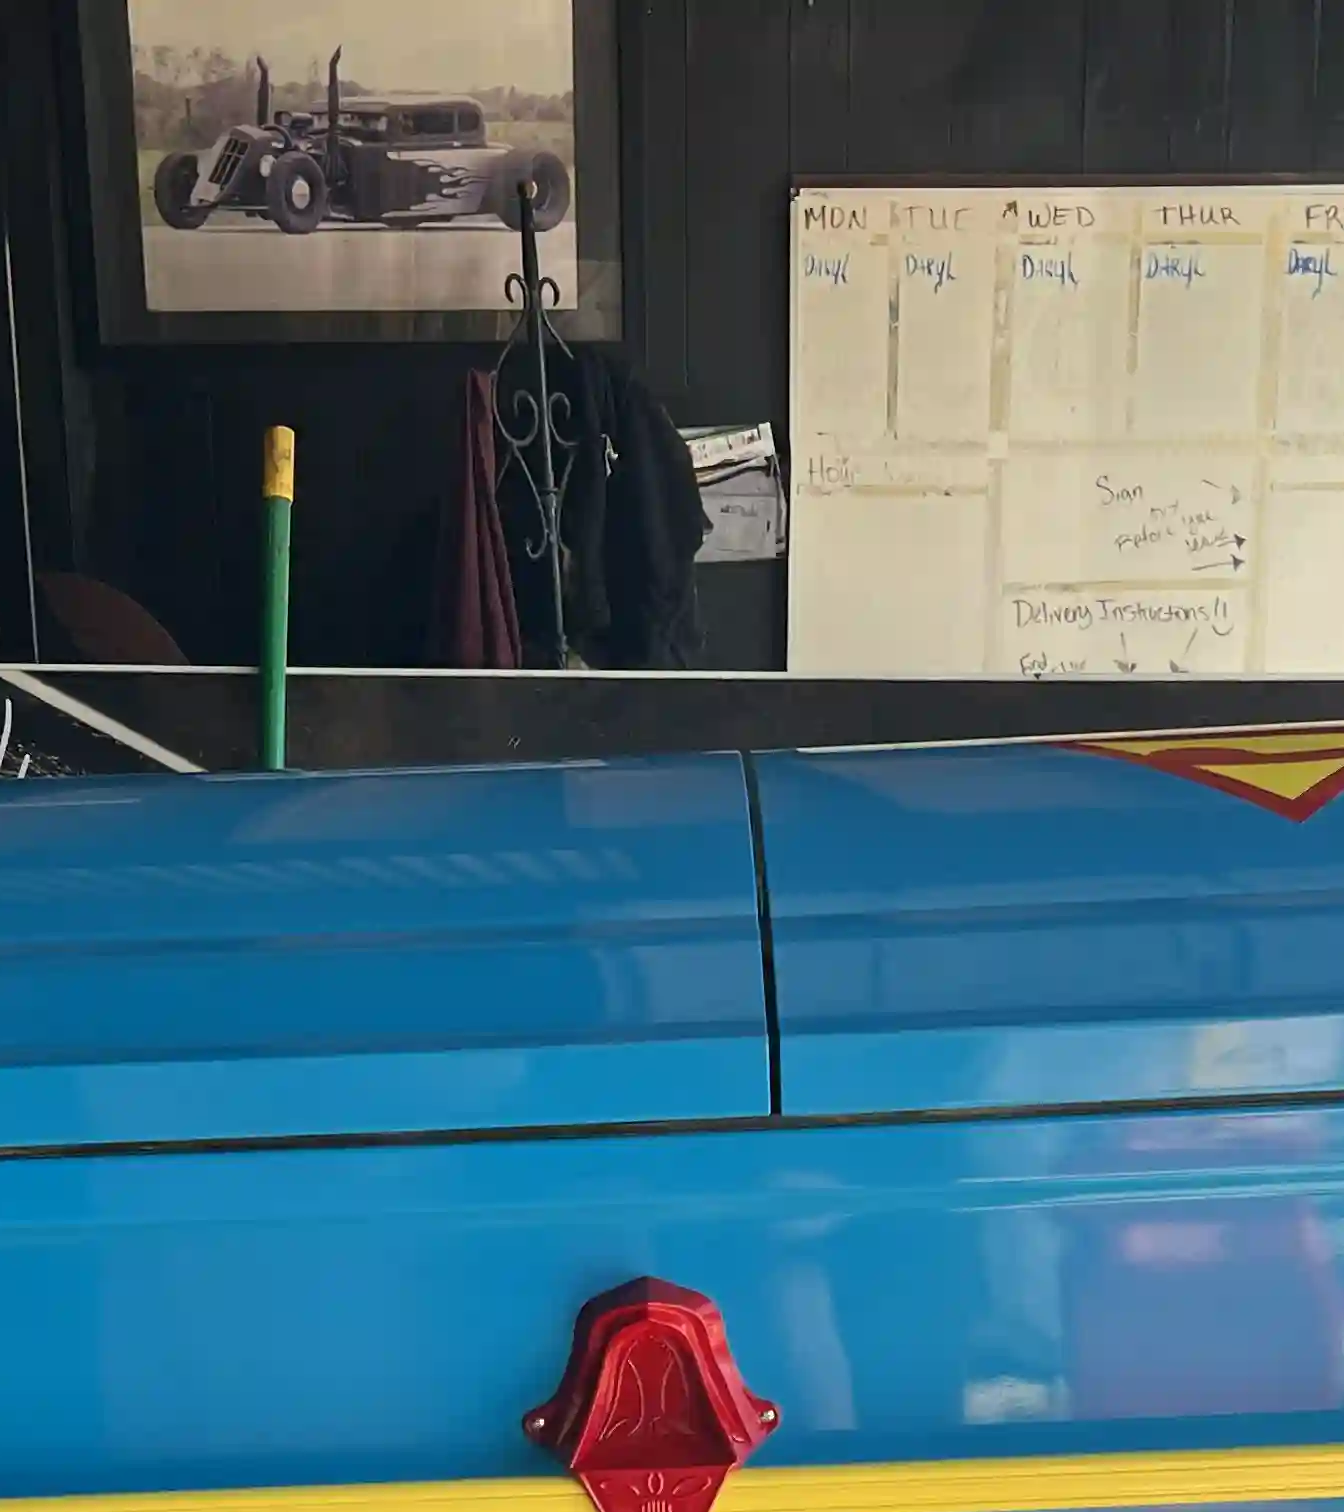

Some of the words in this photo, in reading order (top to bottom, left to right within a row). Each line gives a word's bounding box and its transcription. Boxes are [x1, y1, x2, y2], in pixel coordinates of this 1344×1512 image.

[804, 205, 866, 230] MON
[1028, 205, 1095, 229] WED
[1153, 205, 1241, 227] THUR
